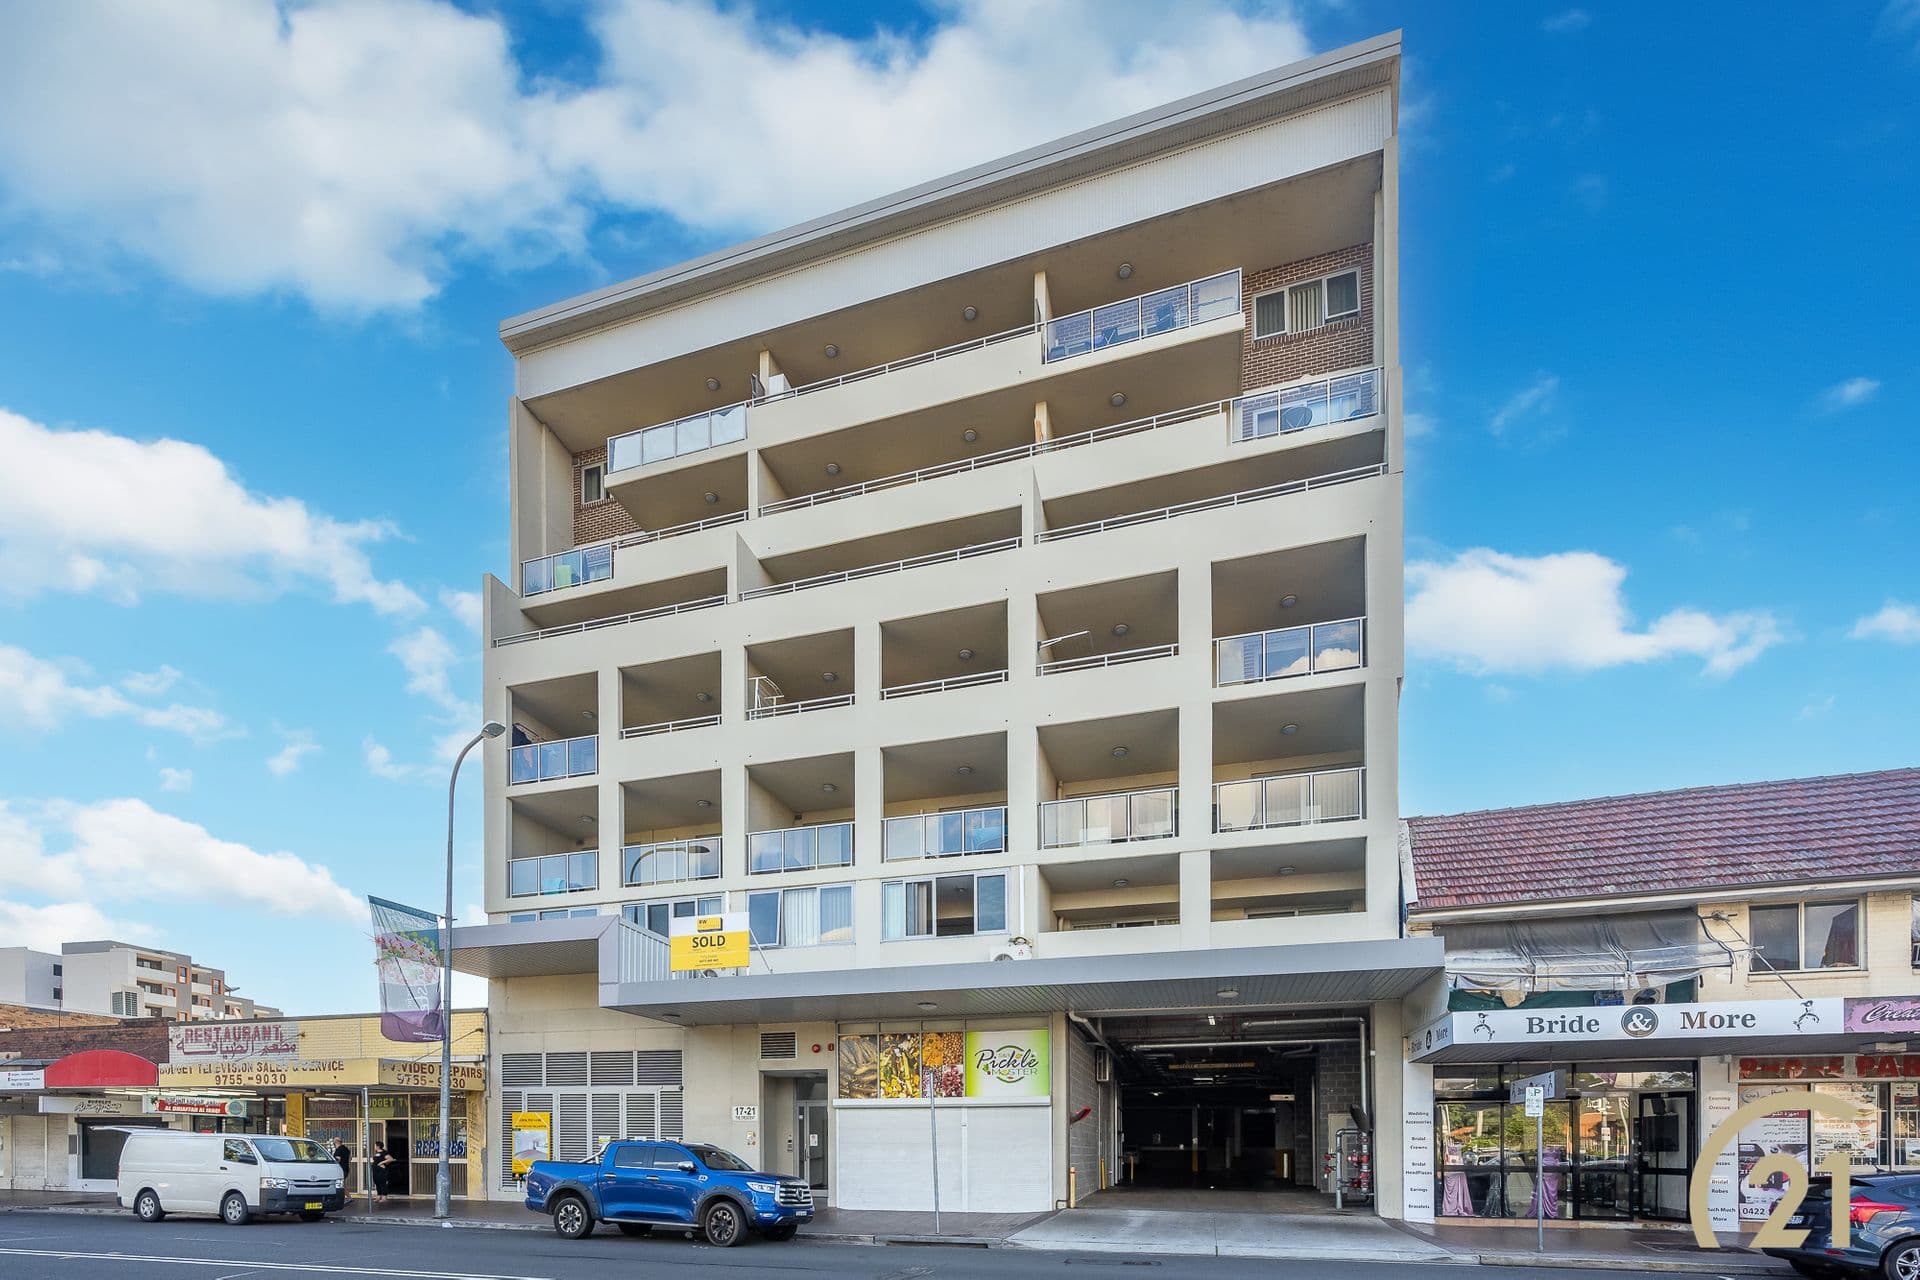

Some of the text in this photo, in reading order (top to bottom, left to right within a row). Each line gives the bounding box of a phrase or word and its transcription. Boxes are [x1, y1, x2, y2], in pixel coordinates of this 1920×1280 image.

[692, 935, 726, 948] SOLD
[1526, 1014, 1600, 1034] Bride
[1680, 1010, 1757, 1030] More
[184, 1025, 282, 1044] RESTAURANT
[974, 1048, 1039, 1069] Pickle
[1742, 1207, 1766, 1216] 0422
